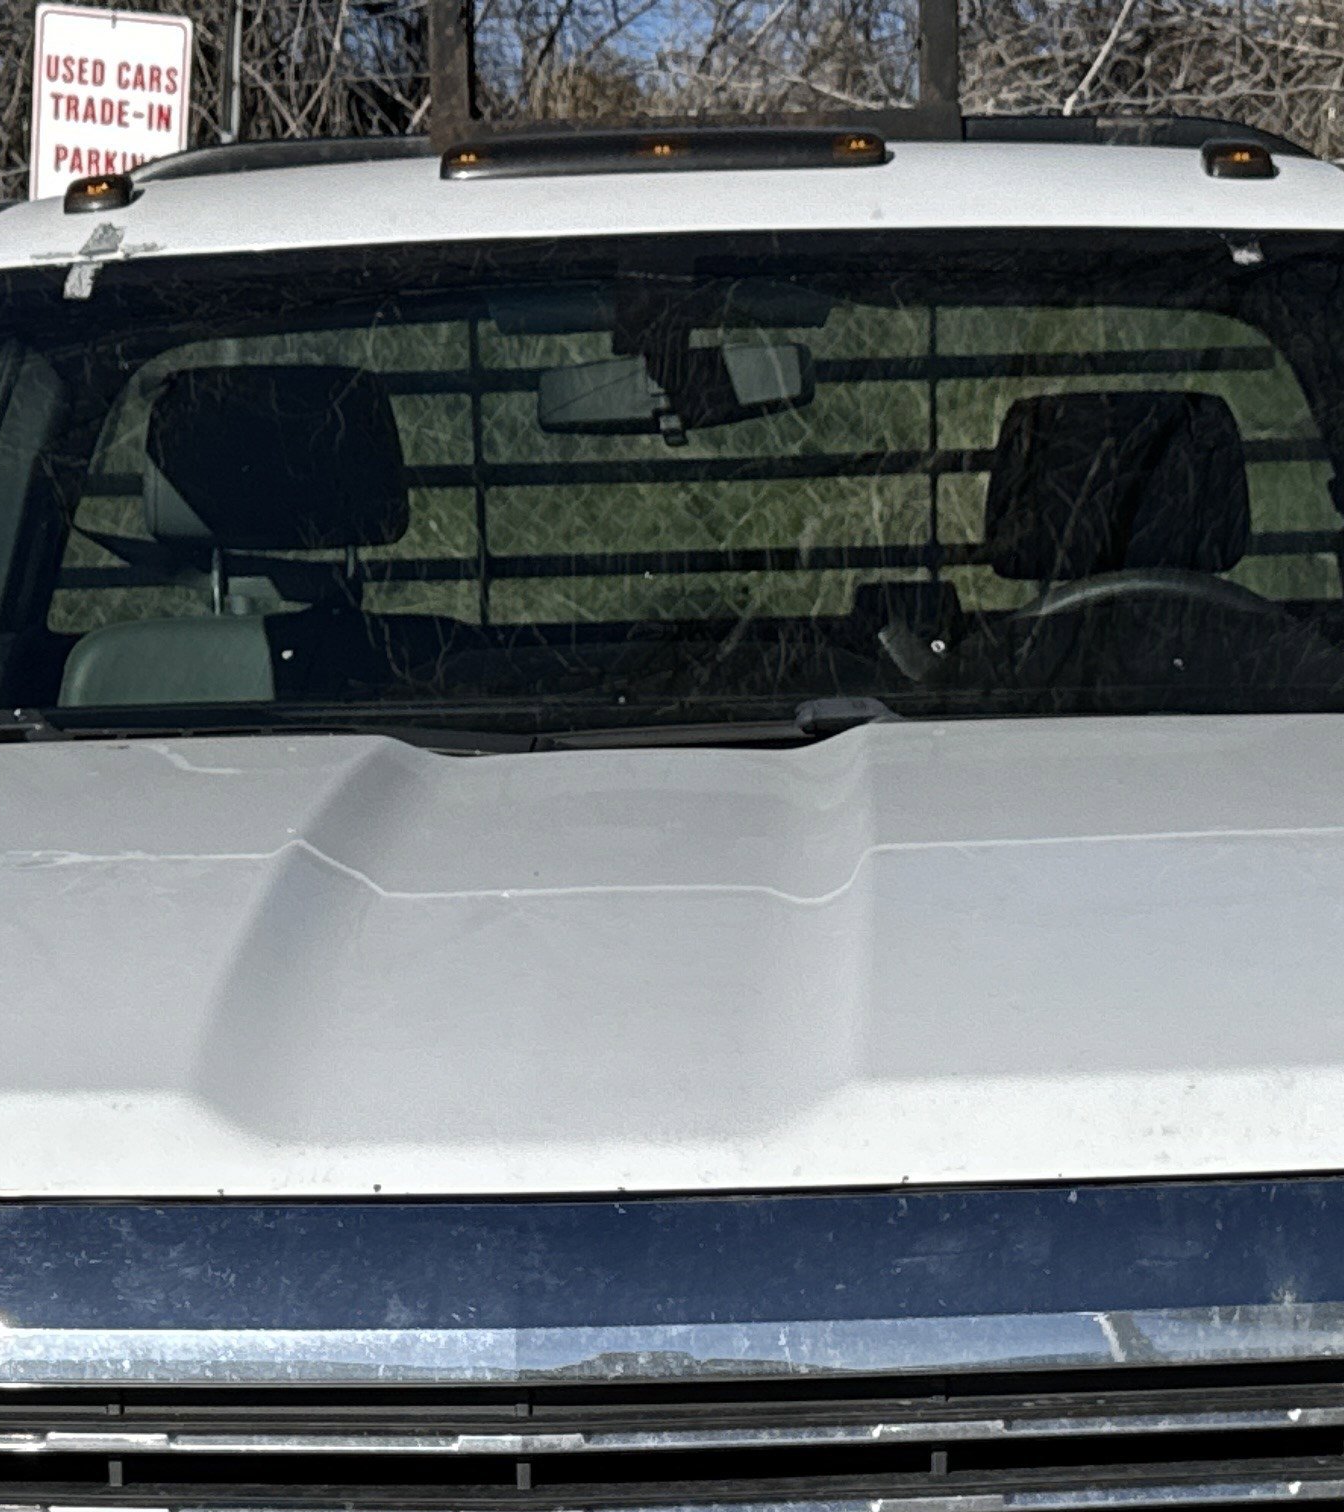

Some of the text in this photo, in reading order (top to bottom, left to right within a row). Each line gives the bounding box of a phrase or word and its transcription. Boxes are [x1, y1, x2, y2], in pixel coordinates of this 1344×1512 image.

[46, 54, 178, 94] USED CARS
[50, 92, 172, 132] TRADE-IN
[55, 143, 160, 175] PARKI
